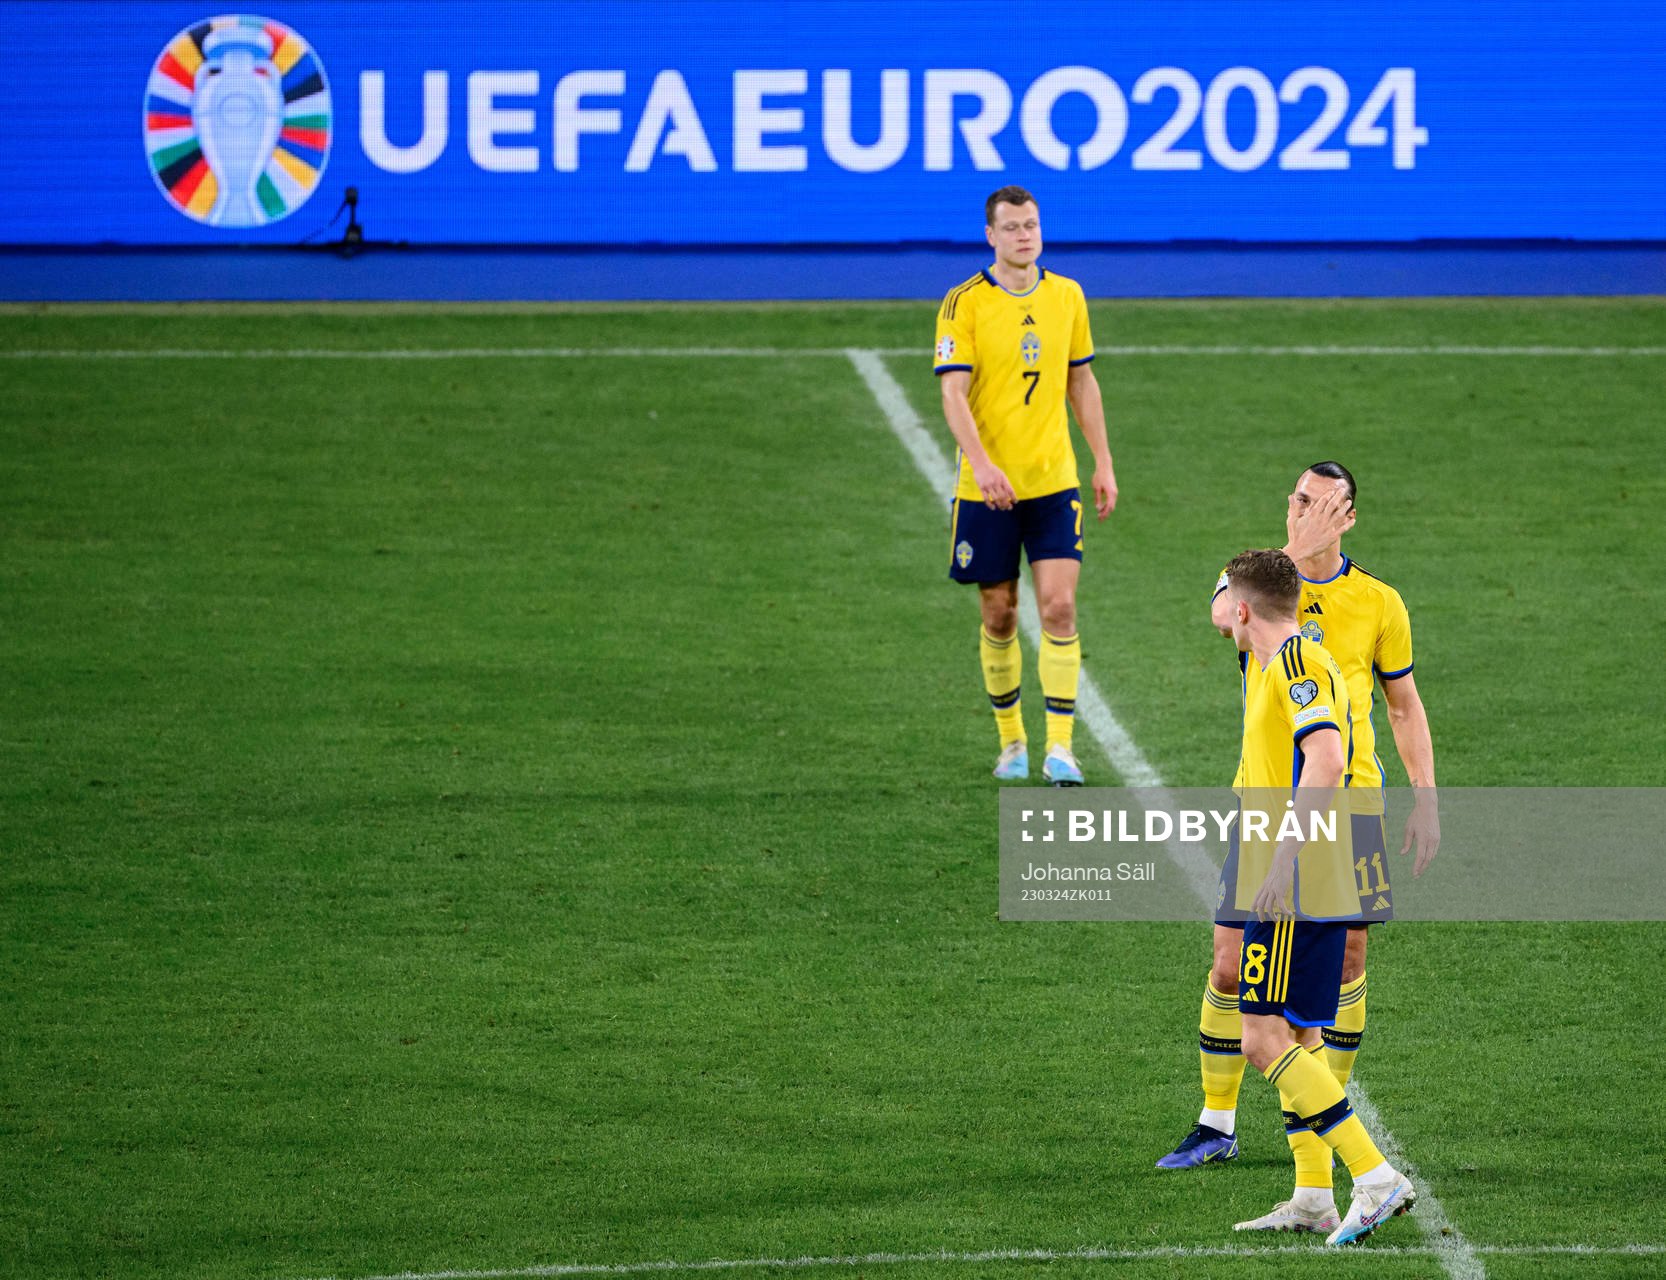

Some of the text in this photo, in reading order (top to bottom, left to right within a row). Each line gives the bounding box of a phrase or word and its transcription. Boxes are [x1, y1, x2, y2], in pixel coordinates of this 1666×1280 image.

[1022, 371, 1041, 406] 7
[1354, 851, 1391, 897] 11
[1322, 1031, 1360, 1043] VERIGE
